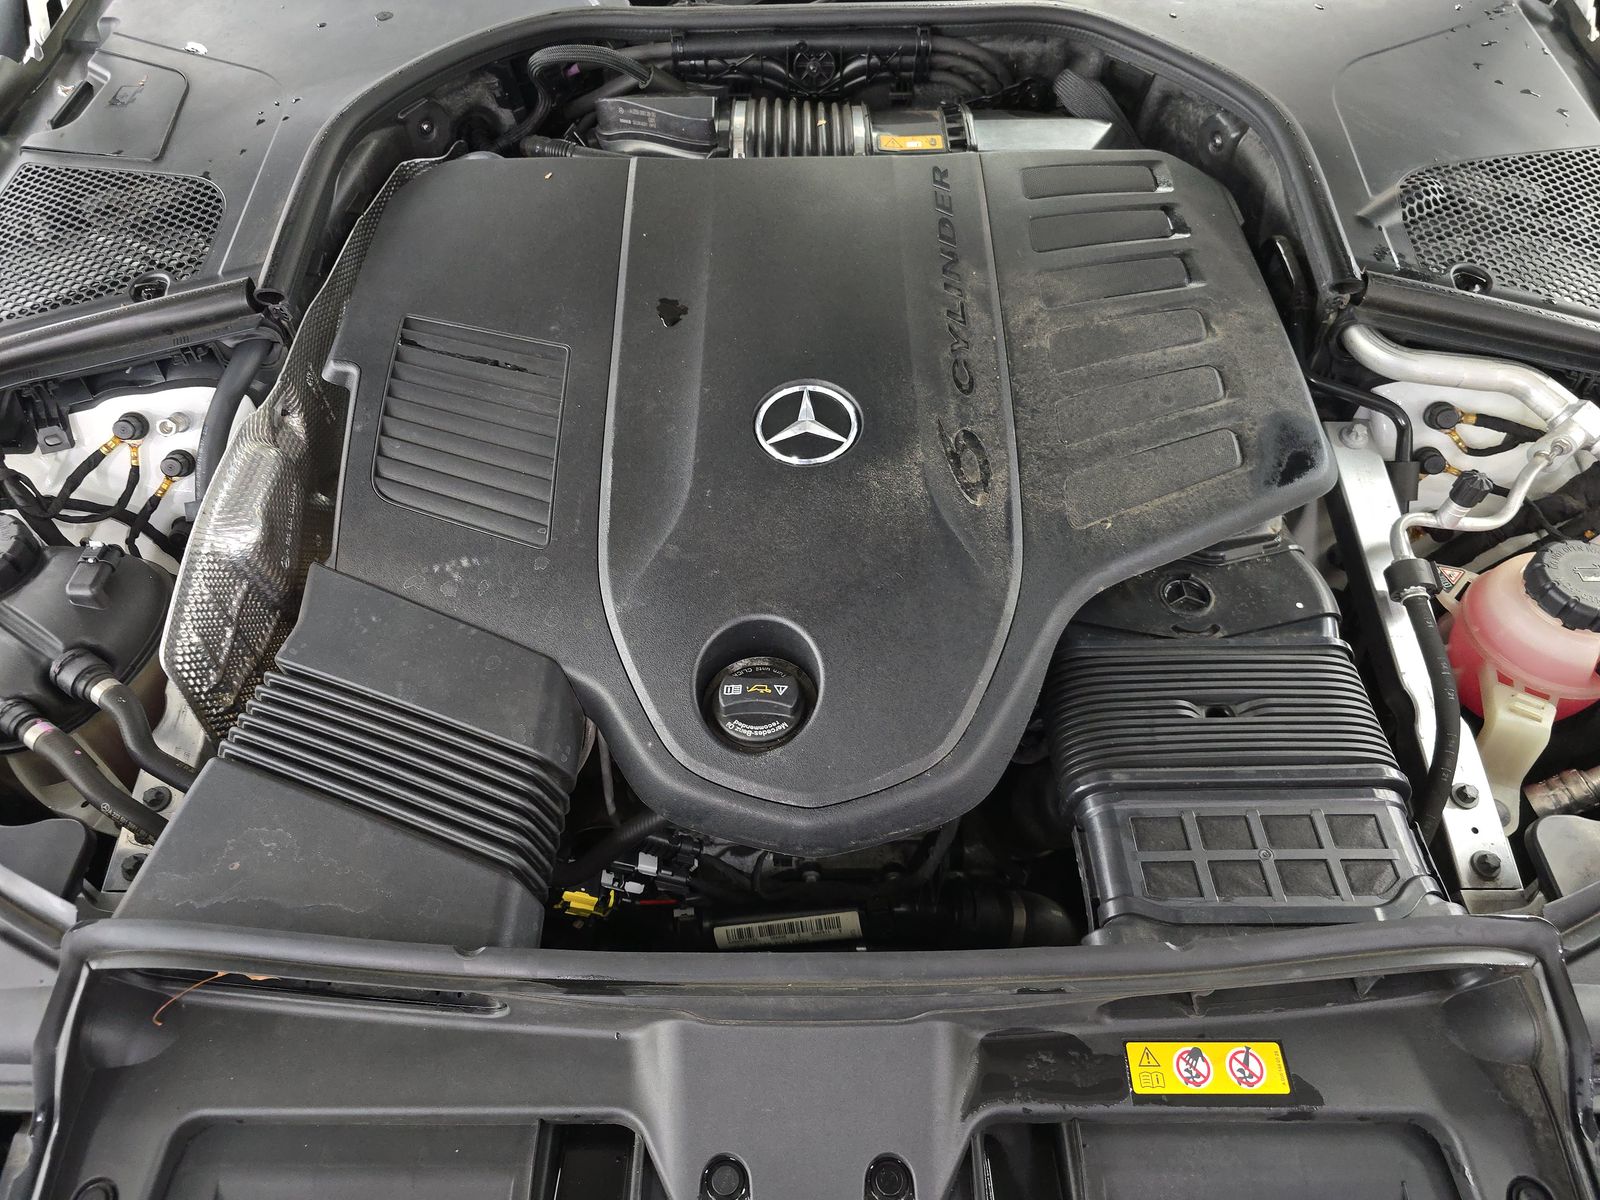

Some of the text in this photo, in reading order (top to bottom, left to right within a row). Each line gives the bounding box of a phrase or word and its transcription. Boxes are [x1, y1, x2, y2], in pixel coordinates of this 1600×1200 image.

[932, 165, 992, 506] 6 CYLINDER
[732, 667, 753, 678] CLICK
[725, 721, 789, 737] Mercedes-Benz Oil
[732, 719, 780, 731] recommended
